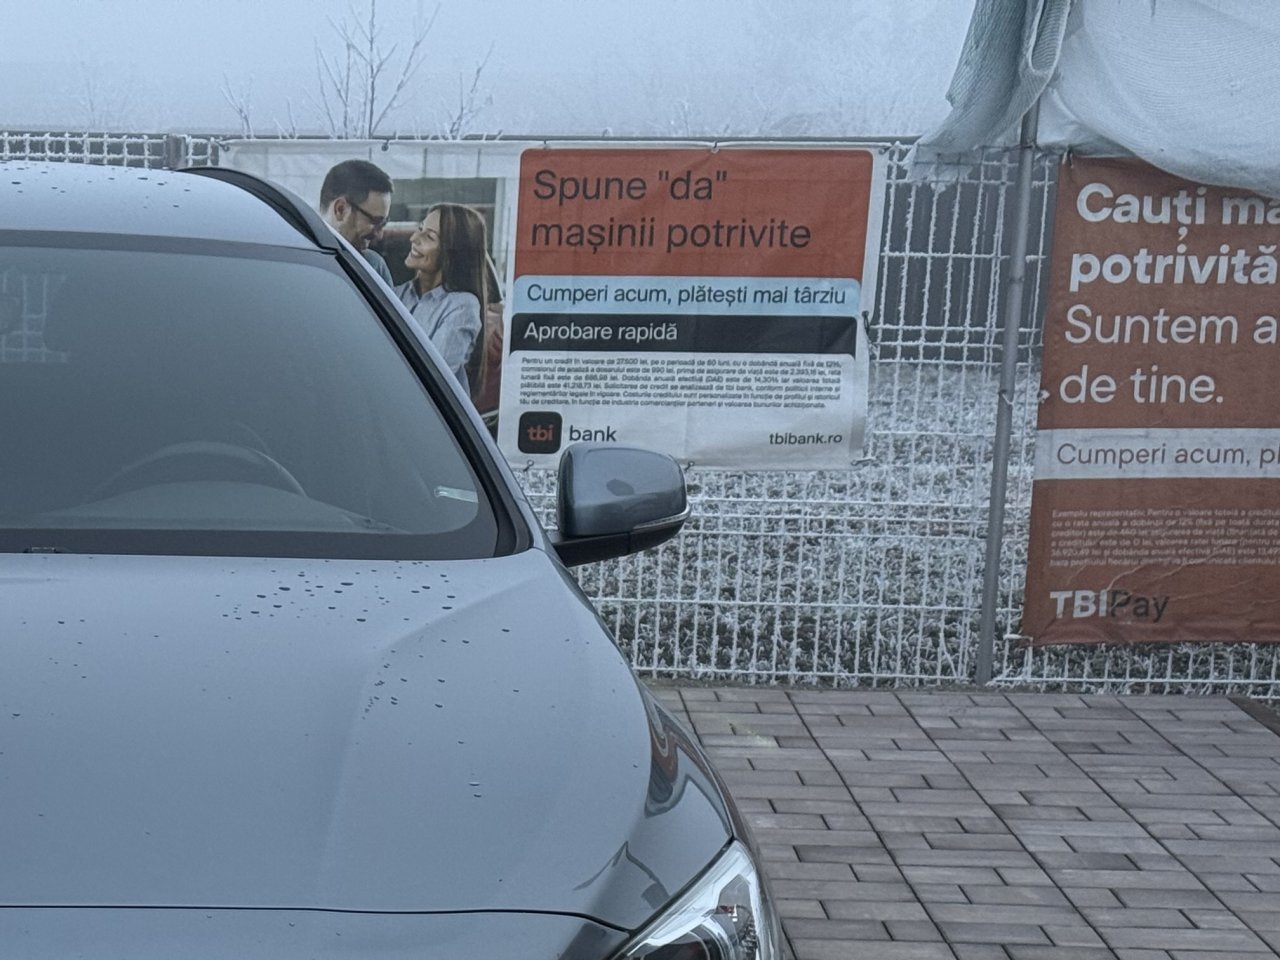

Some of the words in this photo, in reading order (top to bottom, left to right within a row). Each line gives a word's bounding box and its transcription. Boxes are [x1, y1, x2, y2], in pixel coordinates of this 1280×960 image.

[533, 169, 647, 205] Spune
[658, 170, 727, 200] "da"
[1076, 182, 1207, 240] Cauți
[531, 217, 655, 254] mașinii
[667, 218, 811, 253] potrivite
[1069, 244, 1278, 292] potrivită
[527, 284, 608, 304] Cumperi
[614, 288, 671, 304] acum,
[678, 285, 747, 306] plătești
[753, 286, 788, 303] mai
[794, 286, 846, 304] târziu
[524, 321, 612, 342] Aprobare
[618, 322, 677, 343] rapidă
[1064, 304, 1238, 344] Suntem
[1059, 364, 1117, 403] de
[1130, 365, 1224, 404] tine.
[527, 424, 555, 441] tbi
[569, 425, 617, 441] bank
[769, 432, 842, 445] tbibank.ro
[1057, 443, 1166, 469] Cumperi
[1174, 448, 1250, 465] acum,
